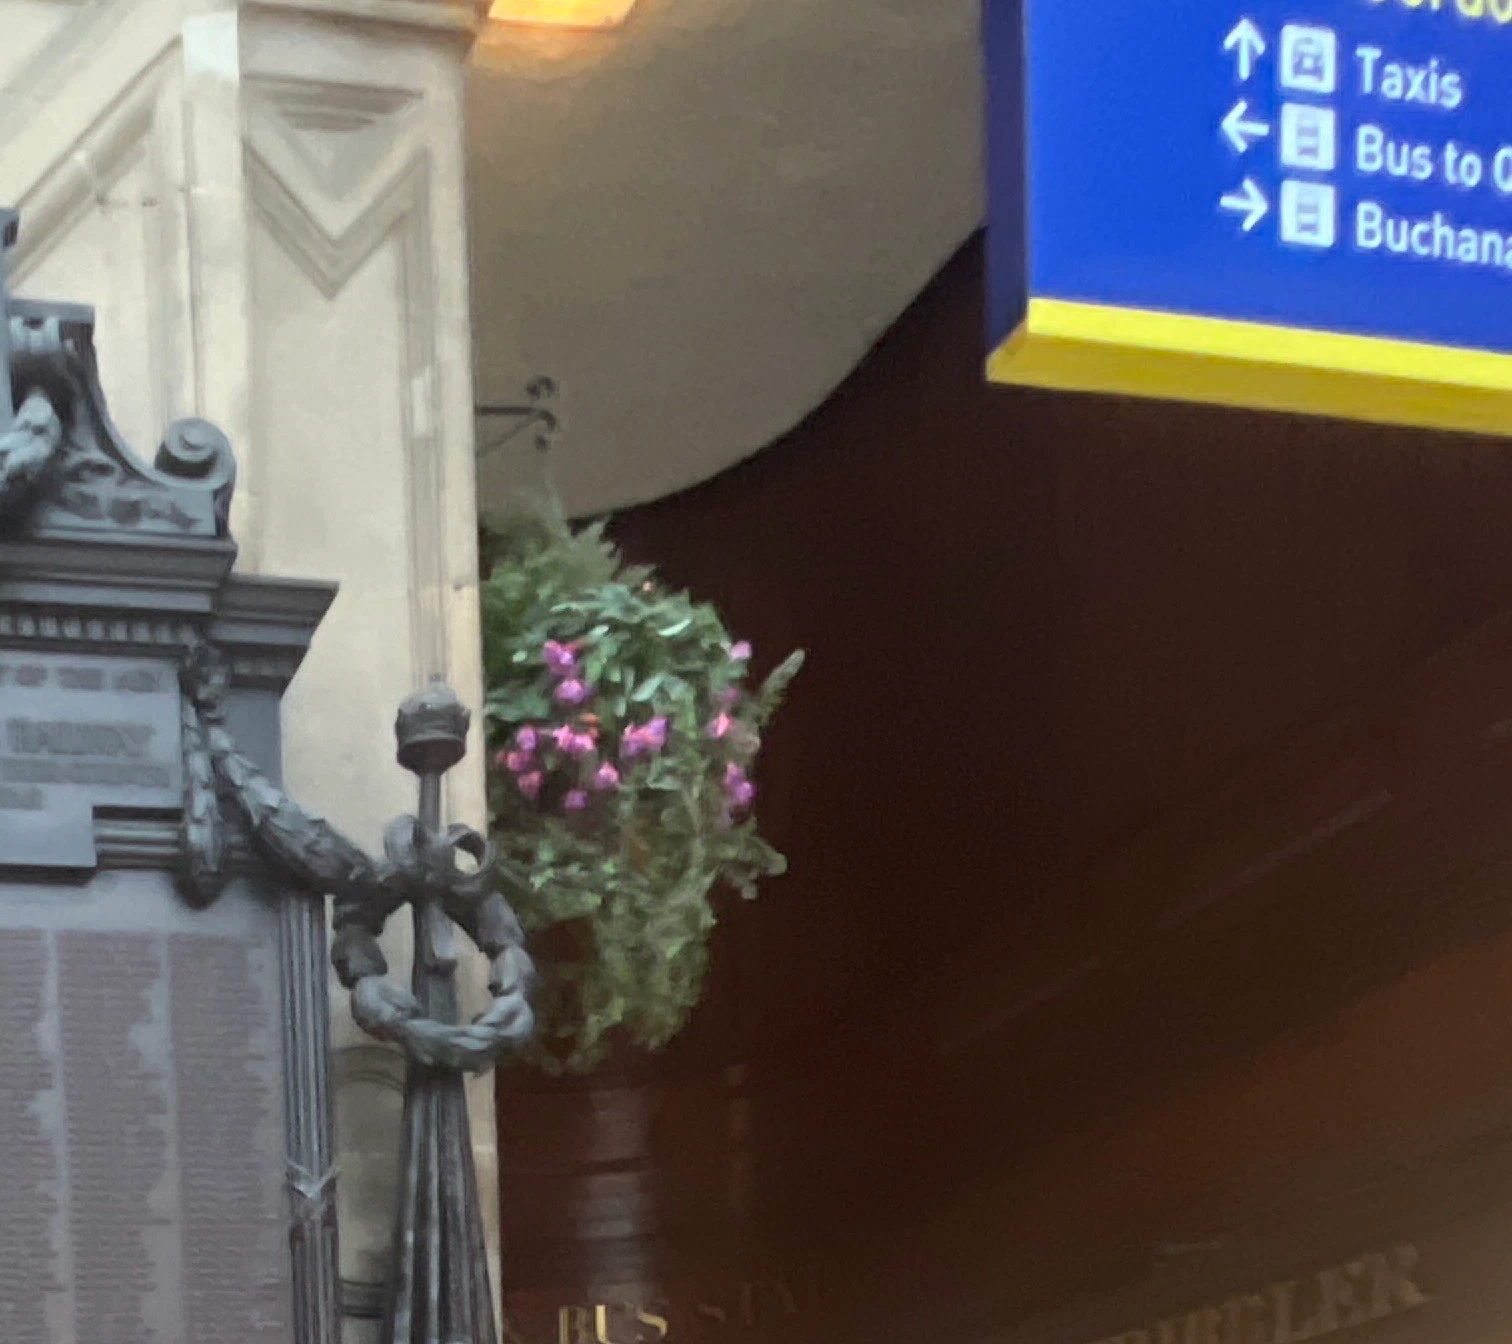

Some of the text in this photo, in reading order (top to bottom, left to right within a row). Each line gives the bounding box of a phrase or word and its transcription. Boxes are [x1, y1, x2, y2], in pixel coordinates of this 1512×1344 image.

[1355, 46, 1464, 109] Taxis
[1356, 124, 1433, 180] Bus
[1445, 142, 1482, 187] to
